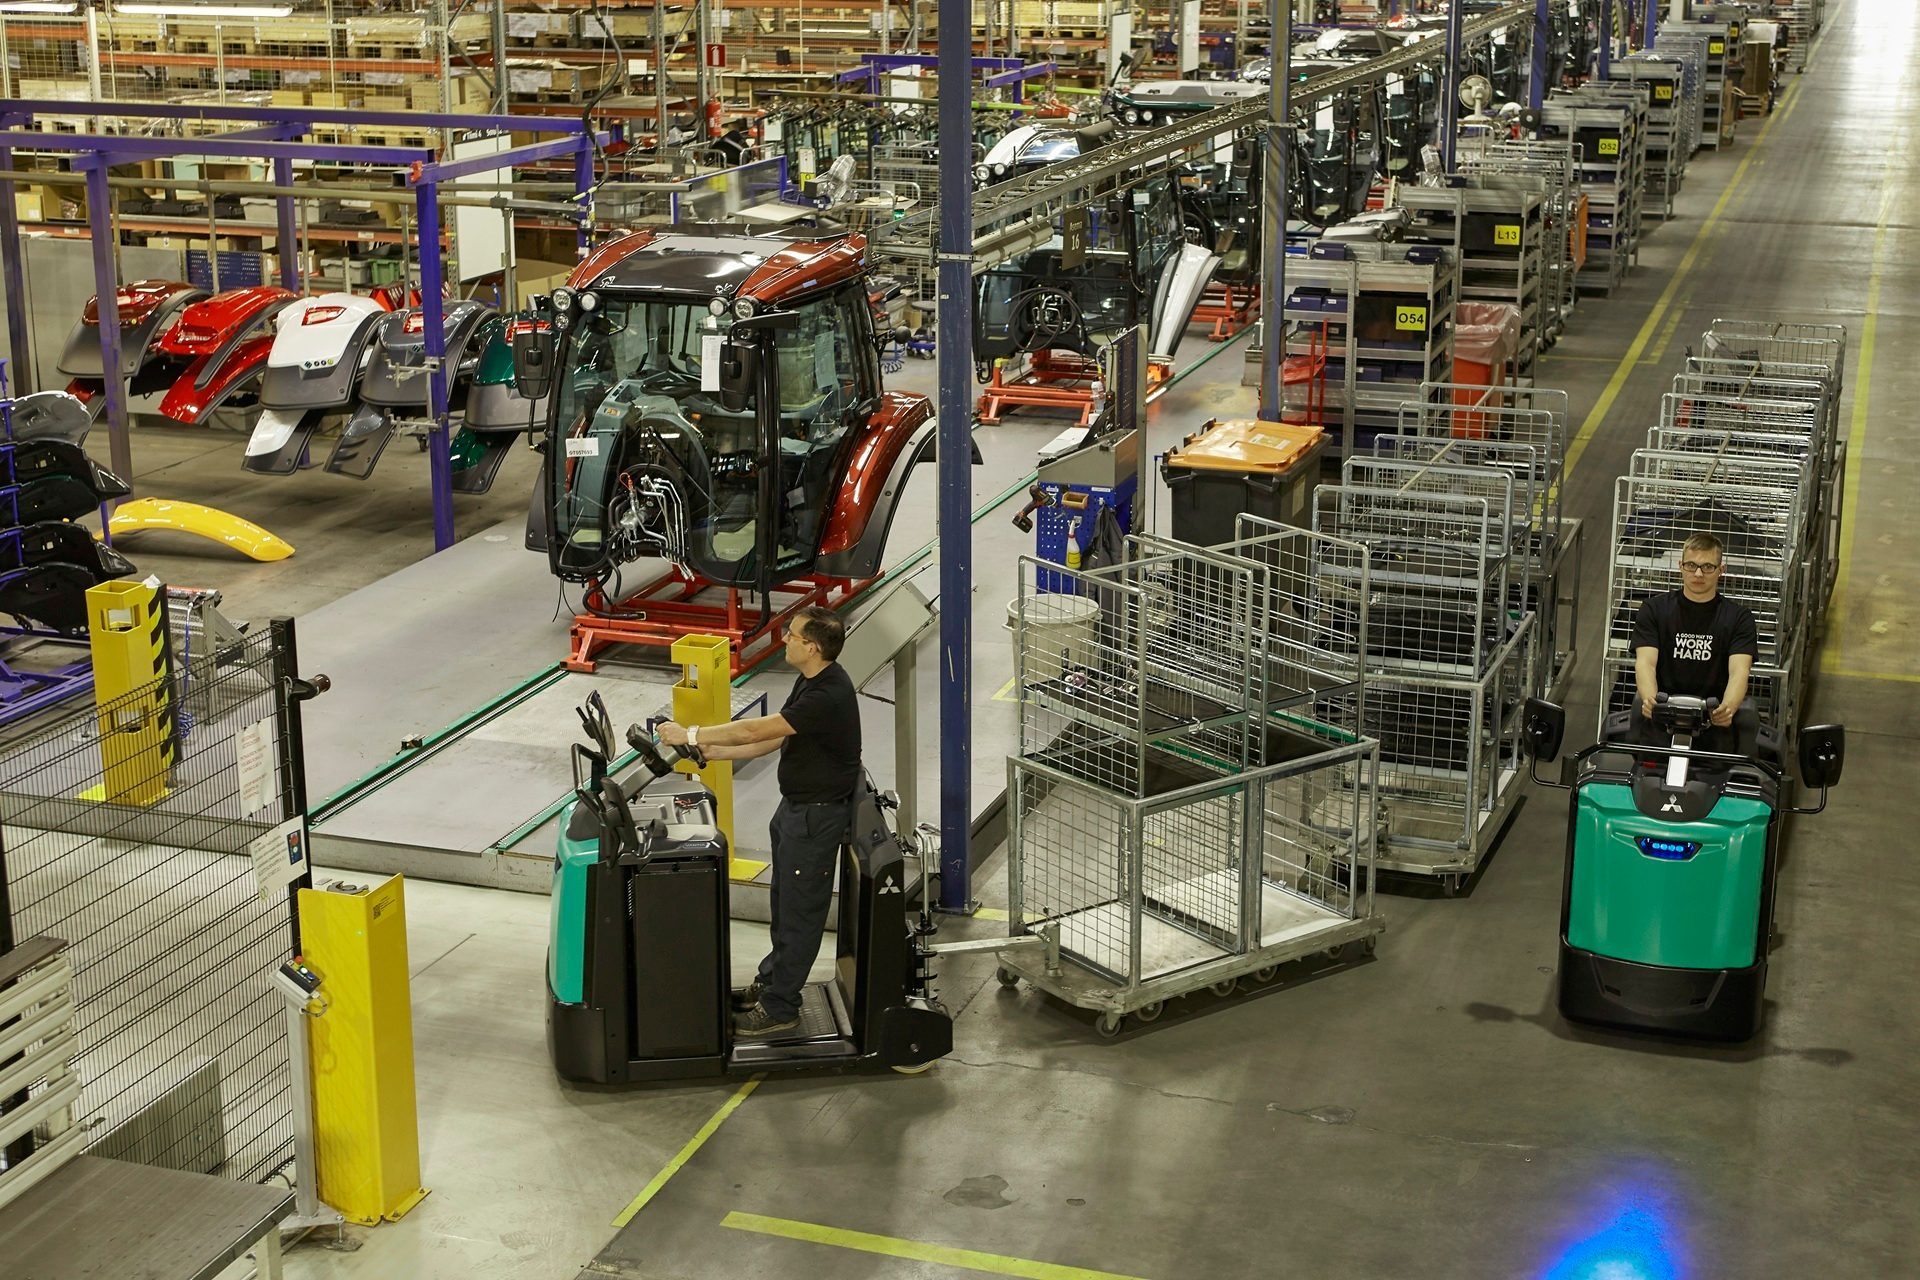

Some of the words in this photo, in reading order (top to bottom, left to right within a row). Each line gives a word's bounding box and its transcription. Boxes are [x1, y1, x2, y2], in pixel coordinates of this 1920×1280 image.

[1600, 143, 1617, 151] O52
[1497, 231, 1517, 240] L13
[1071, 234, 1080, 251] 16
[1398, 312, 1424, 324] O54
[1675, 637, 1713, 651] WORK
[1673, 647, 1712, 661] HARD
